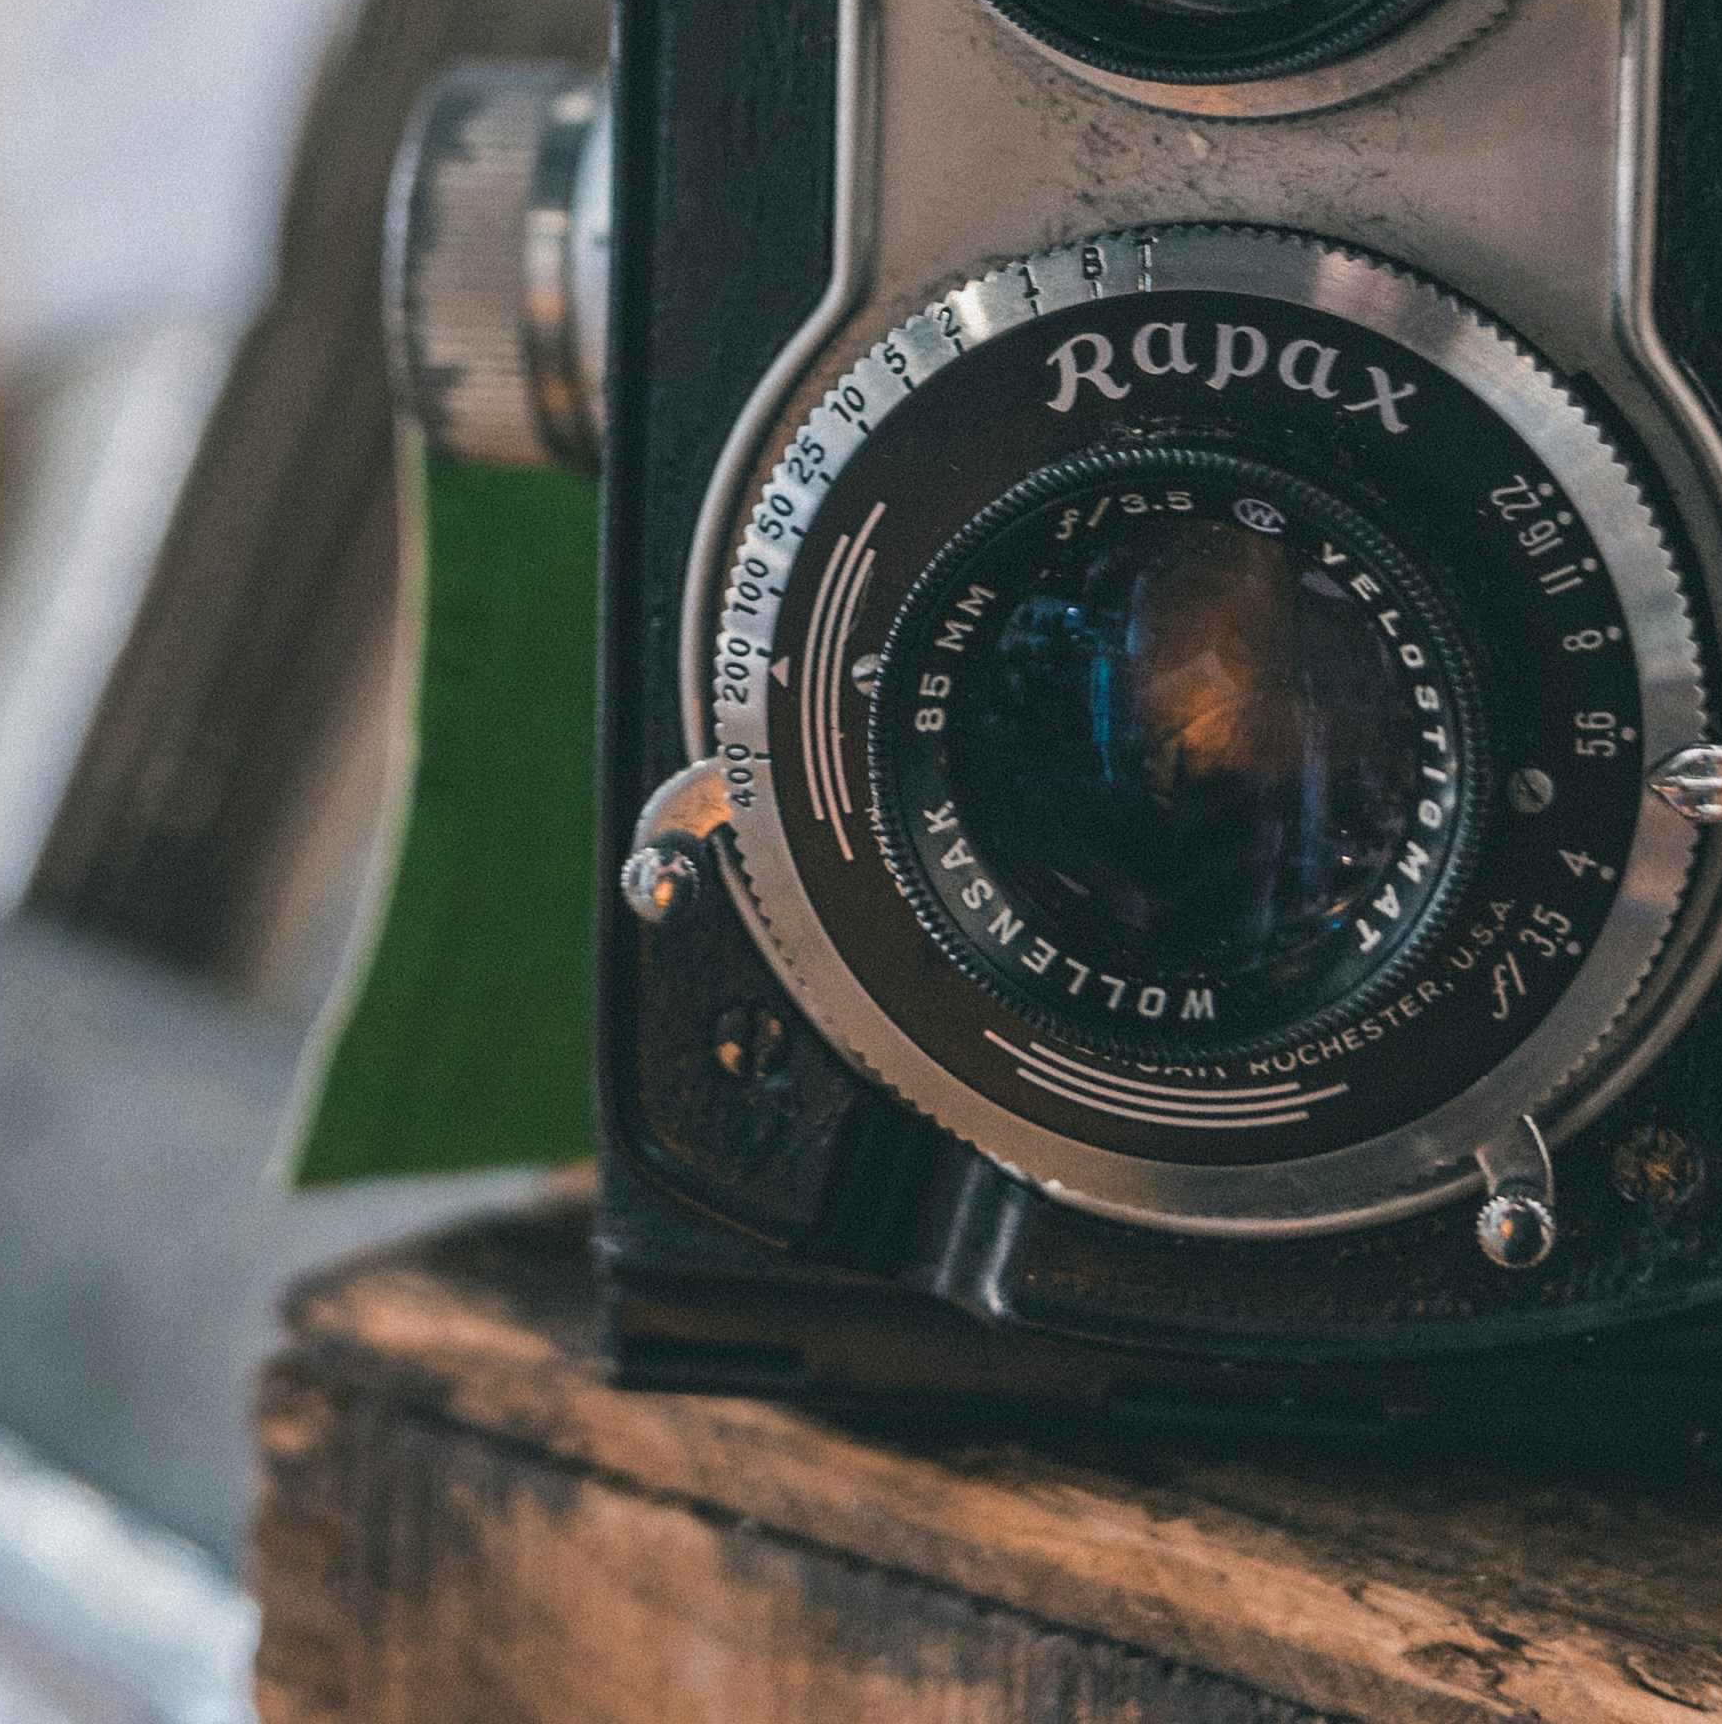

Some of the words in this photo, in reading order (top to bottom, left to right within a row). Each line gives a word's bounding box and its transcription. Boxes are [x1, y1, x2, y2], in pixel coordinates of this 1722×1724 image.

[1081, 244, 1107, 280] B
[1133, 235, 1159, 269] T
[1016, 264, 1040, 299] 1
[936, 306, 962, 338] 2
[883, 343, 907, 376] 5
[1045, 320, 1418, 433] Rapax
[829, 385, 866, 424] 10
[786, 435, 827, 484] 25
[758, 493, 795, 541] 50
[1055, 490, 1194, 541] f/3.5
[1490, 475, 1542, 522] 22
[1518, 519, 1565, 557] 16
[732, 557, 770, 616] 100
[1538, 564, 1583, 595] 11
[914, 673, 951, 733] 85
[934, 584, 997, 652] MM
[1562, 629, 1604, 651] 8
[723, 637, 752, 705] 200
[1574, 711, 1616, 758] 5.6
[725, 742, 756, 809] 400
[1558, 848, 1597, 877] 4
[923, 800, 1215, 1020] WOLLENSAK
